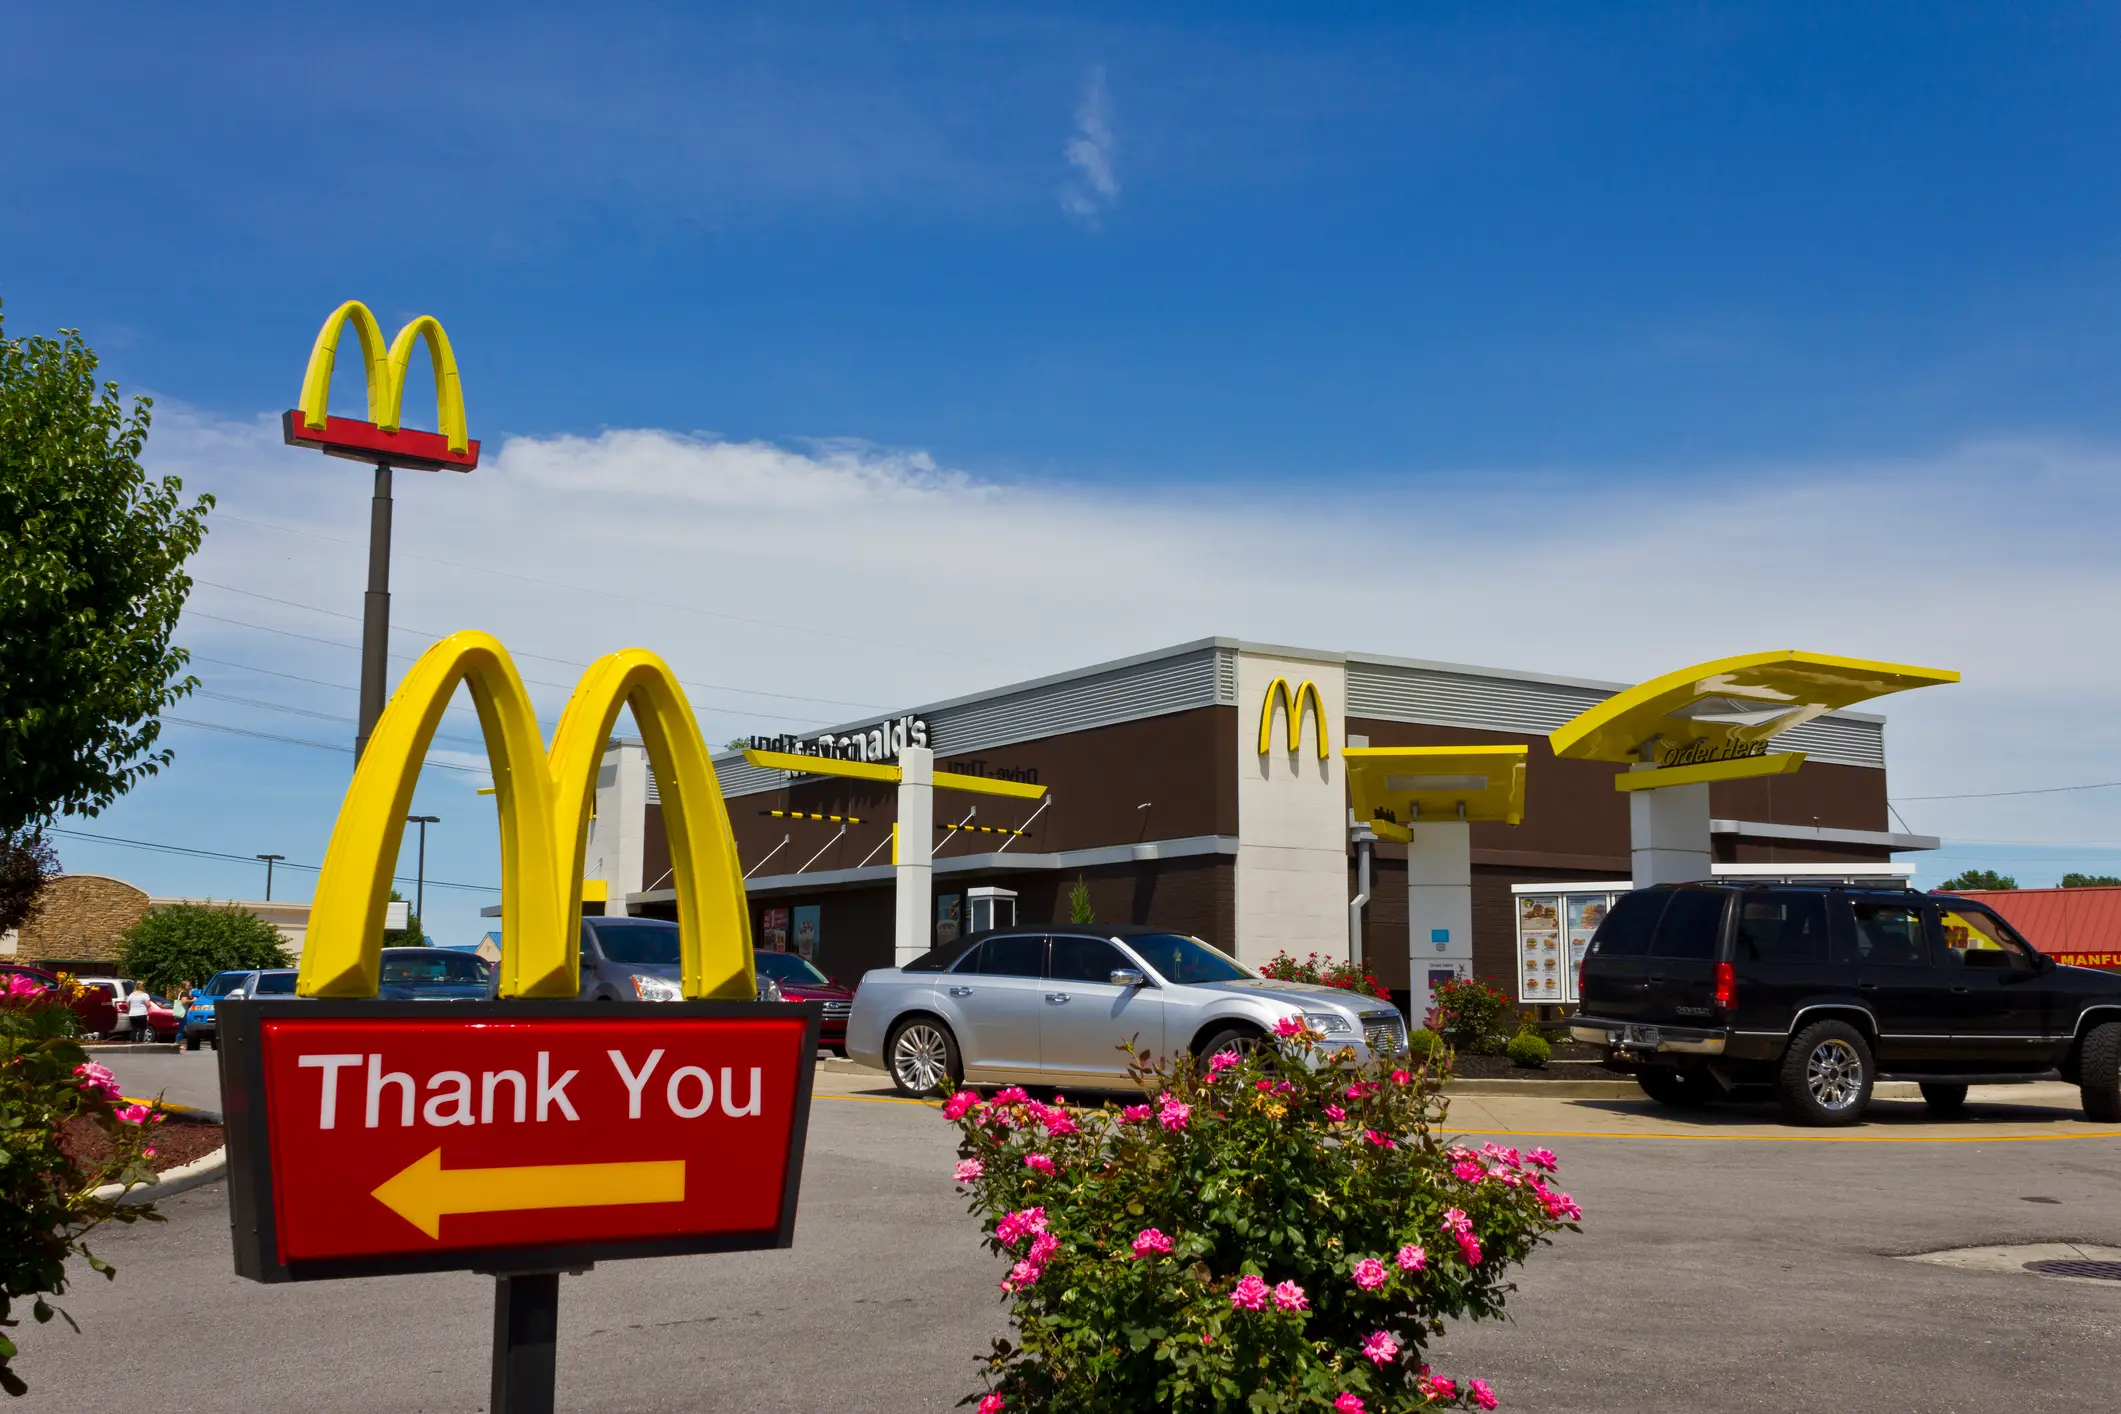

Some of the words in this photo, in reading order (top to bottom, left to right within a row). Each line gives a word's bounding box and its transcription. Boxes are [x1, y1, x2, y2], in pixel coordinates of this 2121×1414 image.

[1662, 742, 1718, 766] Order
[1721, 738, 1768, 758] Here
[298, 1051, 580, 1130] Thank
[607, 1048, 761, 1120] You
